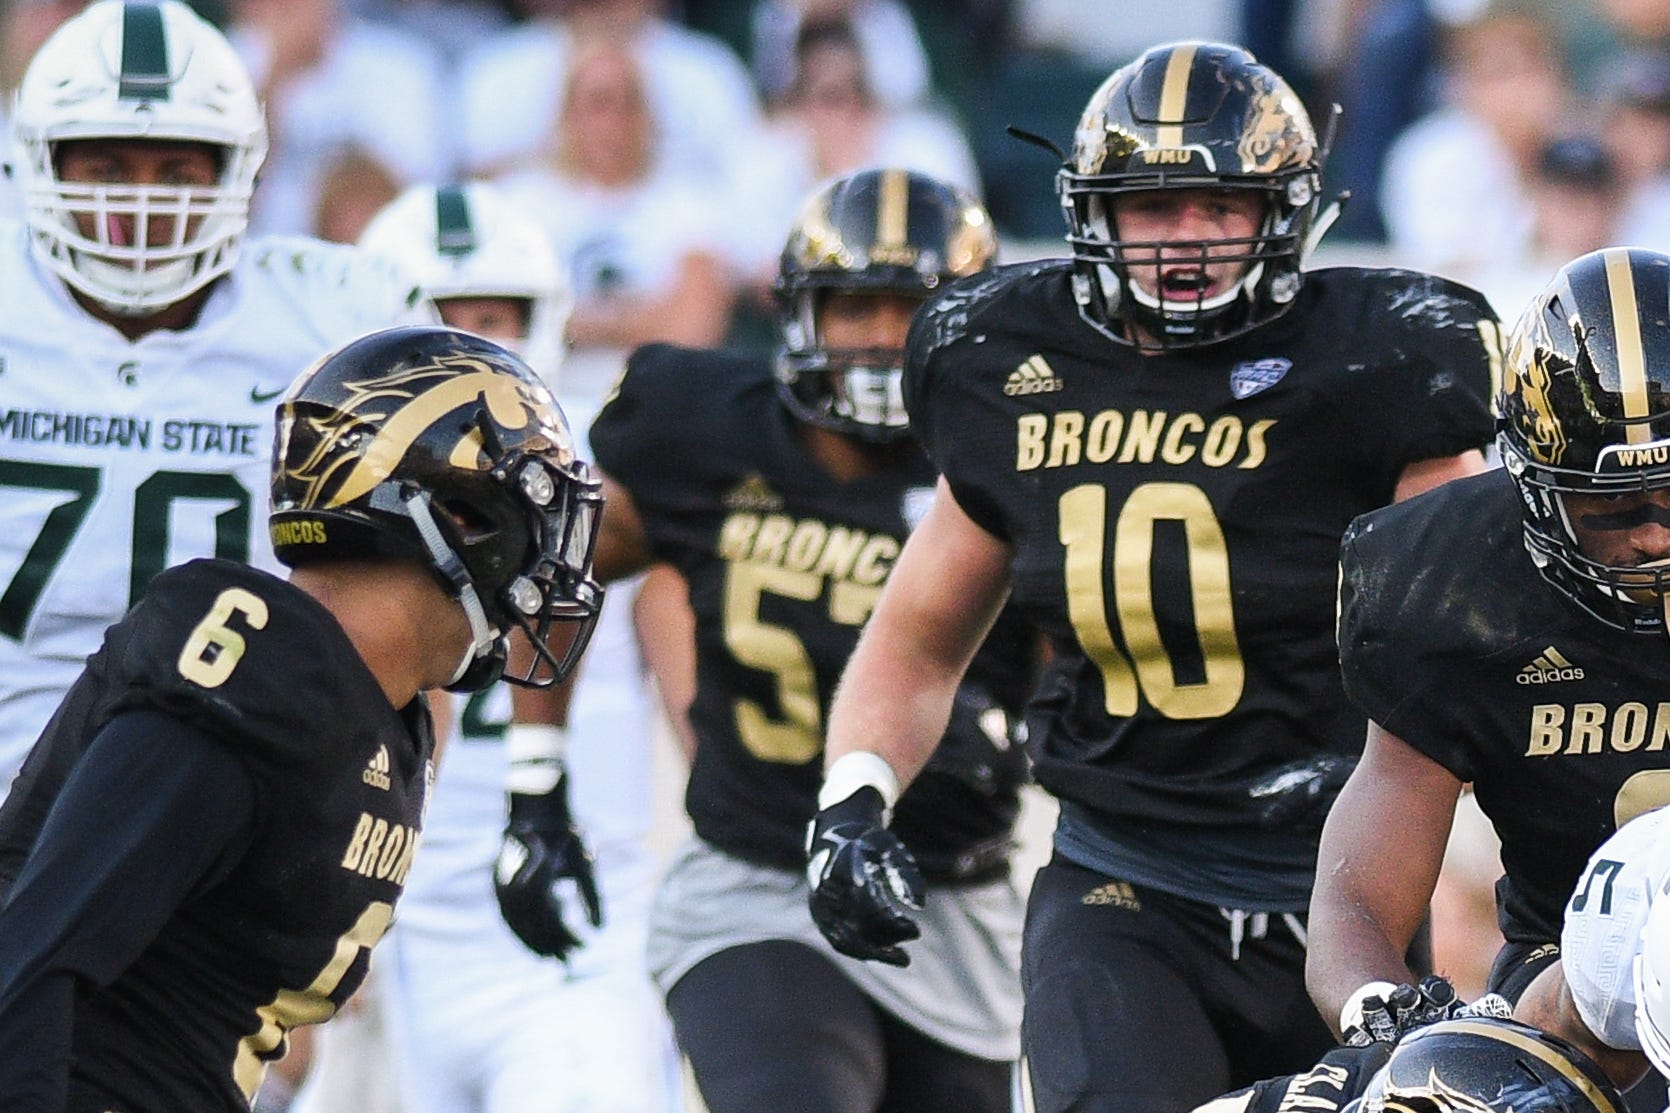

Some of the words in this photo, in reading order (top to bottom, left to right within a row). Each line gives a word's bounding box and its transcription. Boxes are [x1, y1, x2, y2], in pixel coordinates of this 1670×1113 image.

[1143, 149, 1191, 164] WMU
[163, 420, 259, 454] STATE
[1015, 408, 1279, 472] BRONCOS
[1617, 447, 1668, 467] WMU
[717, 512, 900, 578] BRONC
[1058, 482, 1245, 720] 10
[178, 588, 269, 688] 6
[1516, 666, 1585, 685] adidas
[340, 812, 422, 886] BRON
